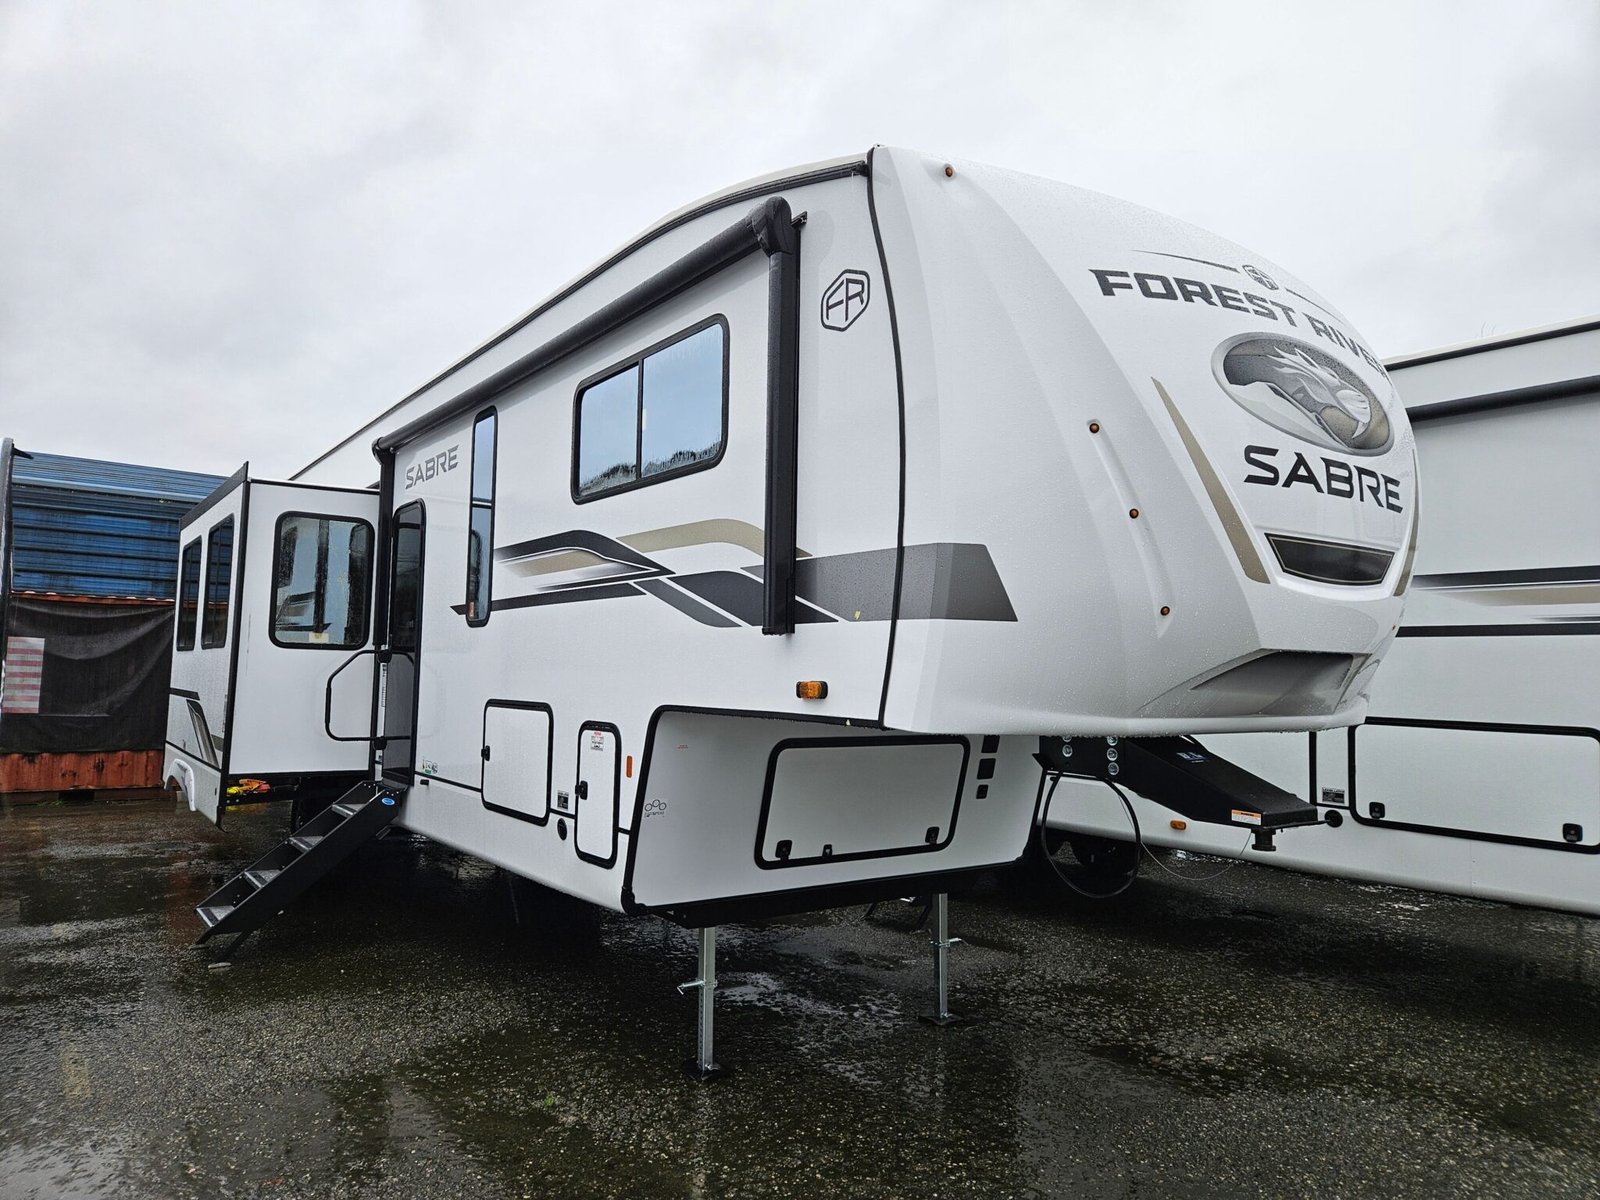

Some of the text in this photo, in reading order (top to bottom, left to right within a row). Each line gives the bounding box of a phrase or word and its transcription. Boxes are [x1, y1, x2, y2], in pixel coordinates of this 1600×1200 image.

[1088, 268, 1299, 328] FOREST
[405, 444, 460, 490] SABRE
[1243, 444, 1404, 514] SABRE
